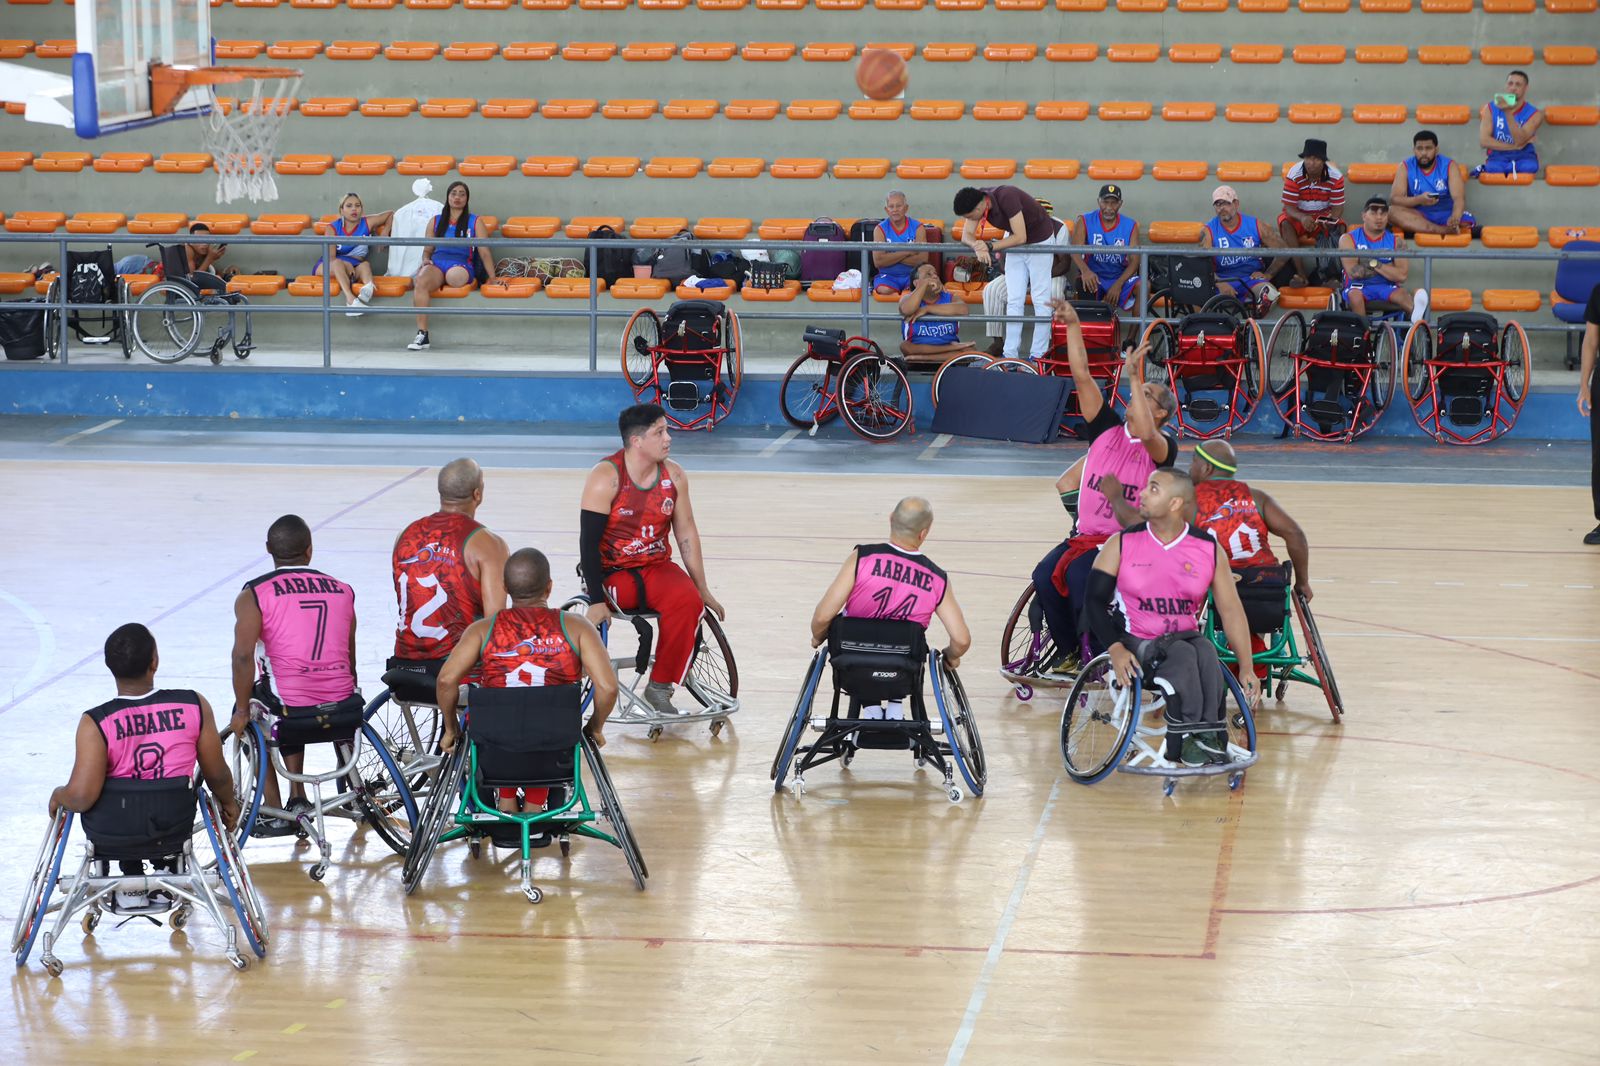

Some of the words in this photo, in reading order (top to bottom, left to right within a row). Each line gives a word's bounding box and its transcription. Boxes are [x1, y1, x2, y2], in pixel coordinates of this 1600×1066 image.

[1218, 236, 1230, 248] 13
[272, 577, 345, 596] AABANE
[872, 558, 934, 593] AABANE
[397, 571, 449, 641] 12
[871, 586, 918, 620] 14
[299, 600, 328, 661] 7
[113, 708, 186, 741] AABANE
